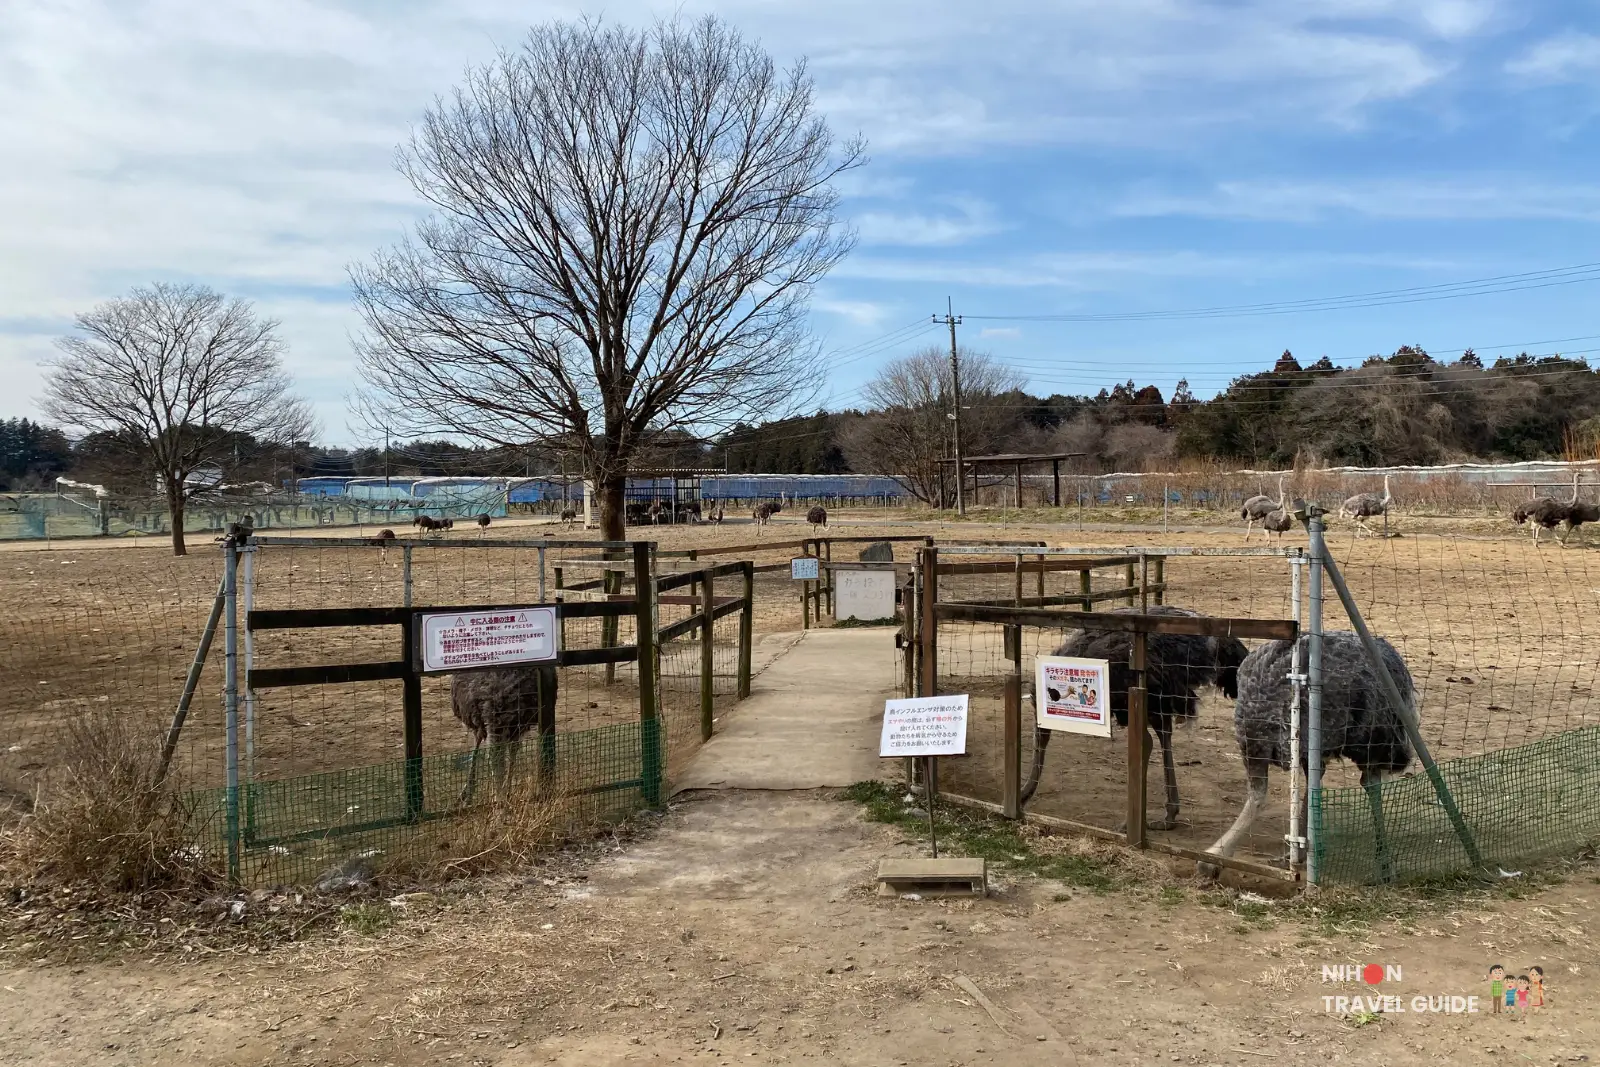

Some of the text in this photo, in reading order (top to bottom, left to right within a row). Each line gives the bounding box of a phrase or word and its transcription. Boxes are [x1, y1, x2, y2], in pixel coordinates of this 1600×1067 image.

[470, 616, 515, 625] 中に入る際の注意
[889, 705, 964, 715] 鳥インフルエンザ対策のため
